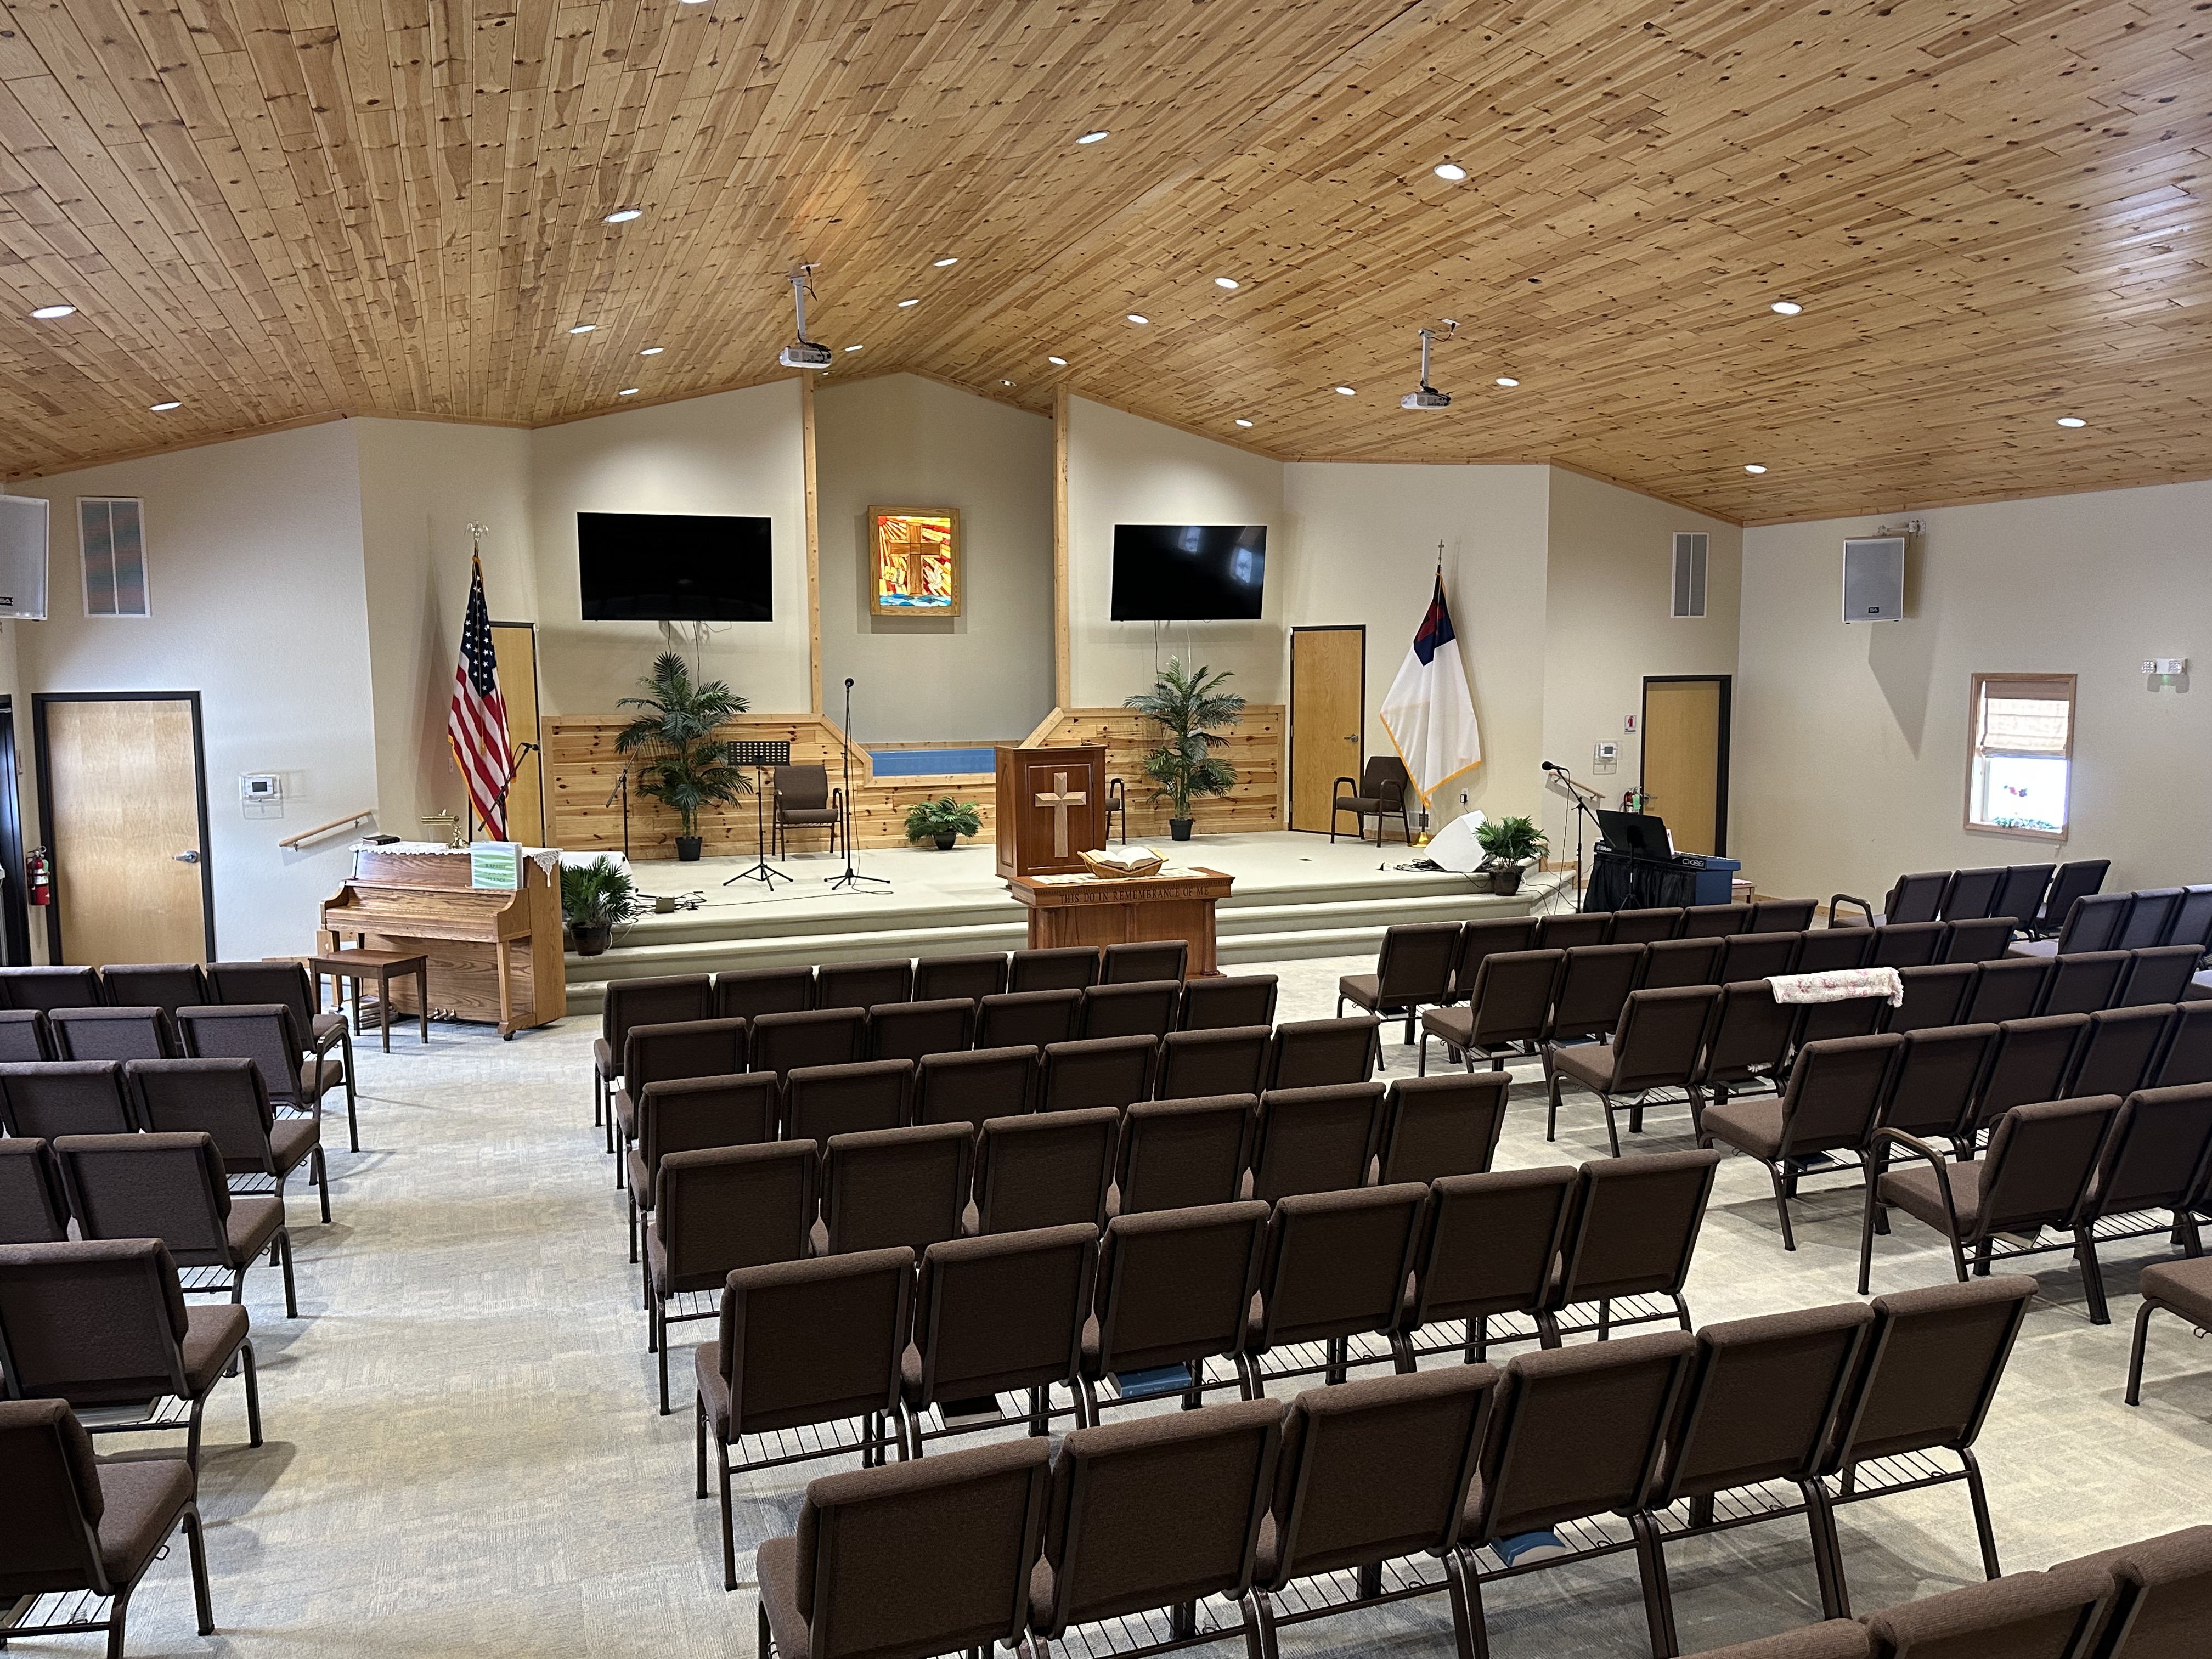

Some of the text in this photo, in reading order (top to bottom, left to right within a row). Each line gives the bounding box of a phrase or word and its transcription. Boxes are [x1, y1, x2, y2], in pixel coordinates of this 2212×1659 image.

[1059, 887, 1209, 904] THIS DO IN REMEMBRANCE OF ME
